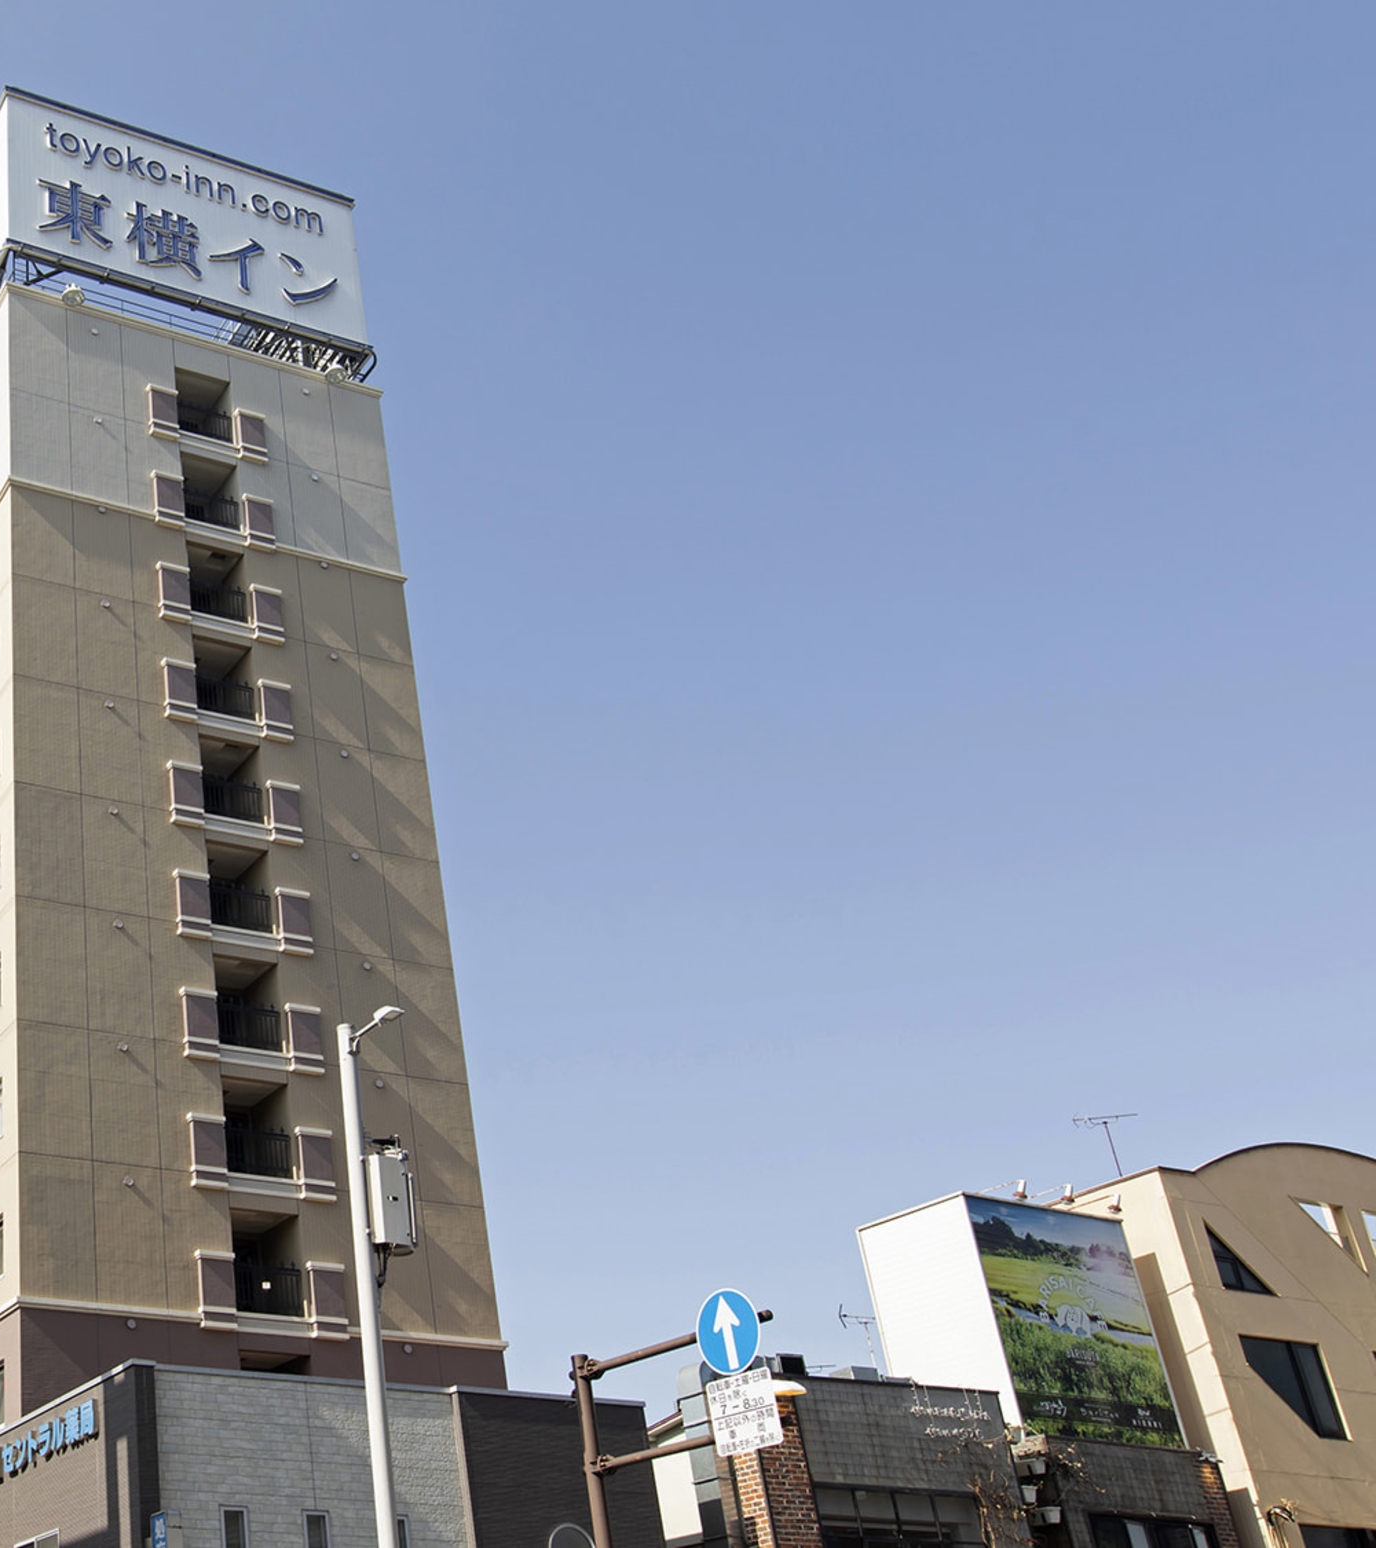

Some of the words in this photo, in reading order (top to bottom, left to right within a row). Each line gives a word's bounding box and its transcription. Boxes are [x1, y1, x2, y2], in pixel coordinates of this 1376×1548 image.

[45, 122, 324, 235] toyoko-inn.com
[37, 177, 338, 306] 東横イン
[1, 1398, 95, 1473] セントラル薬局
